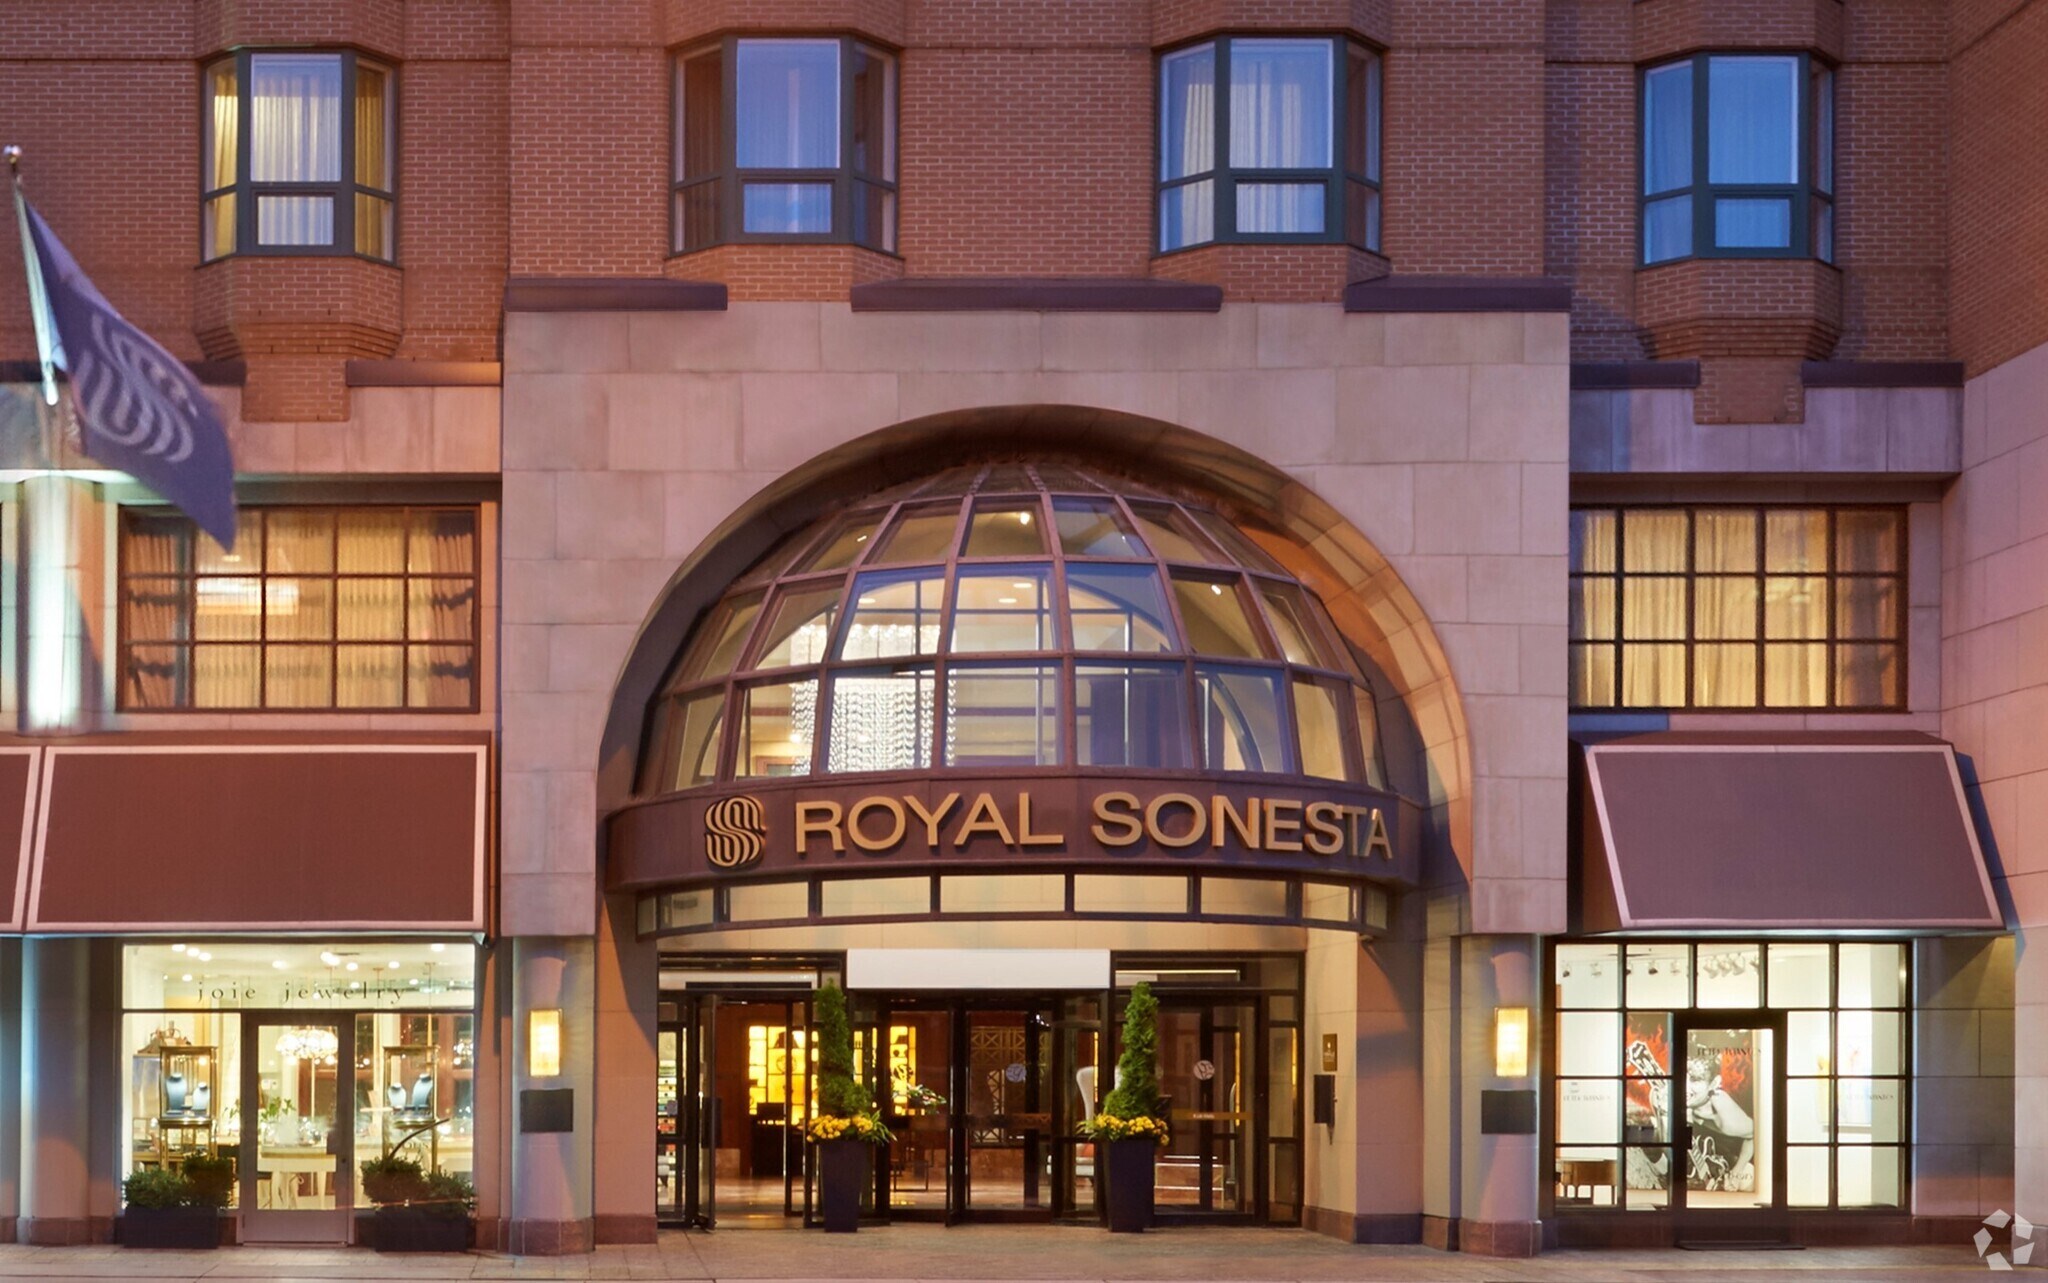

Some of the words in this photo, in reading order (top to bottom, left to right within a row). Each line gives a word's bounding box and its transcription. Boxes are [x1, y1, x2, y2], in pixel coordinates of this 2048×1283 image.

[796, 792, 1064, 853] ROYAL
[1091, 791, 1393, 860] SONESTA
[197, 981, 256, 1002] joie
[281, 981, 406, 1005] jewelry
